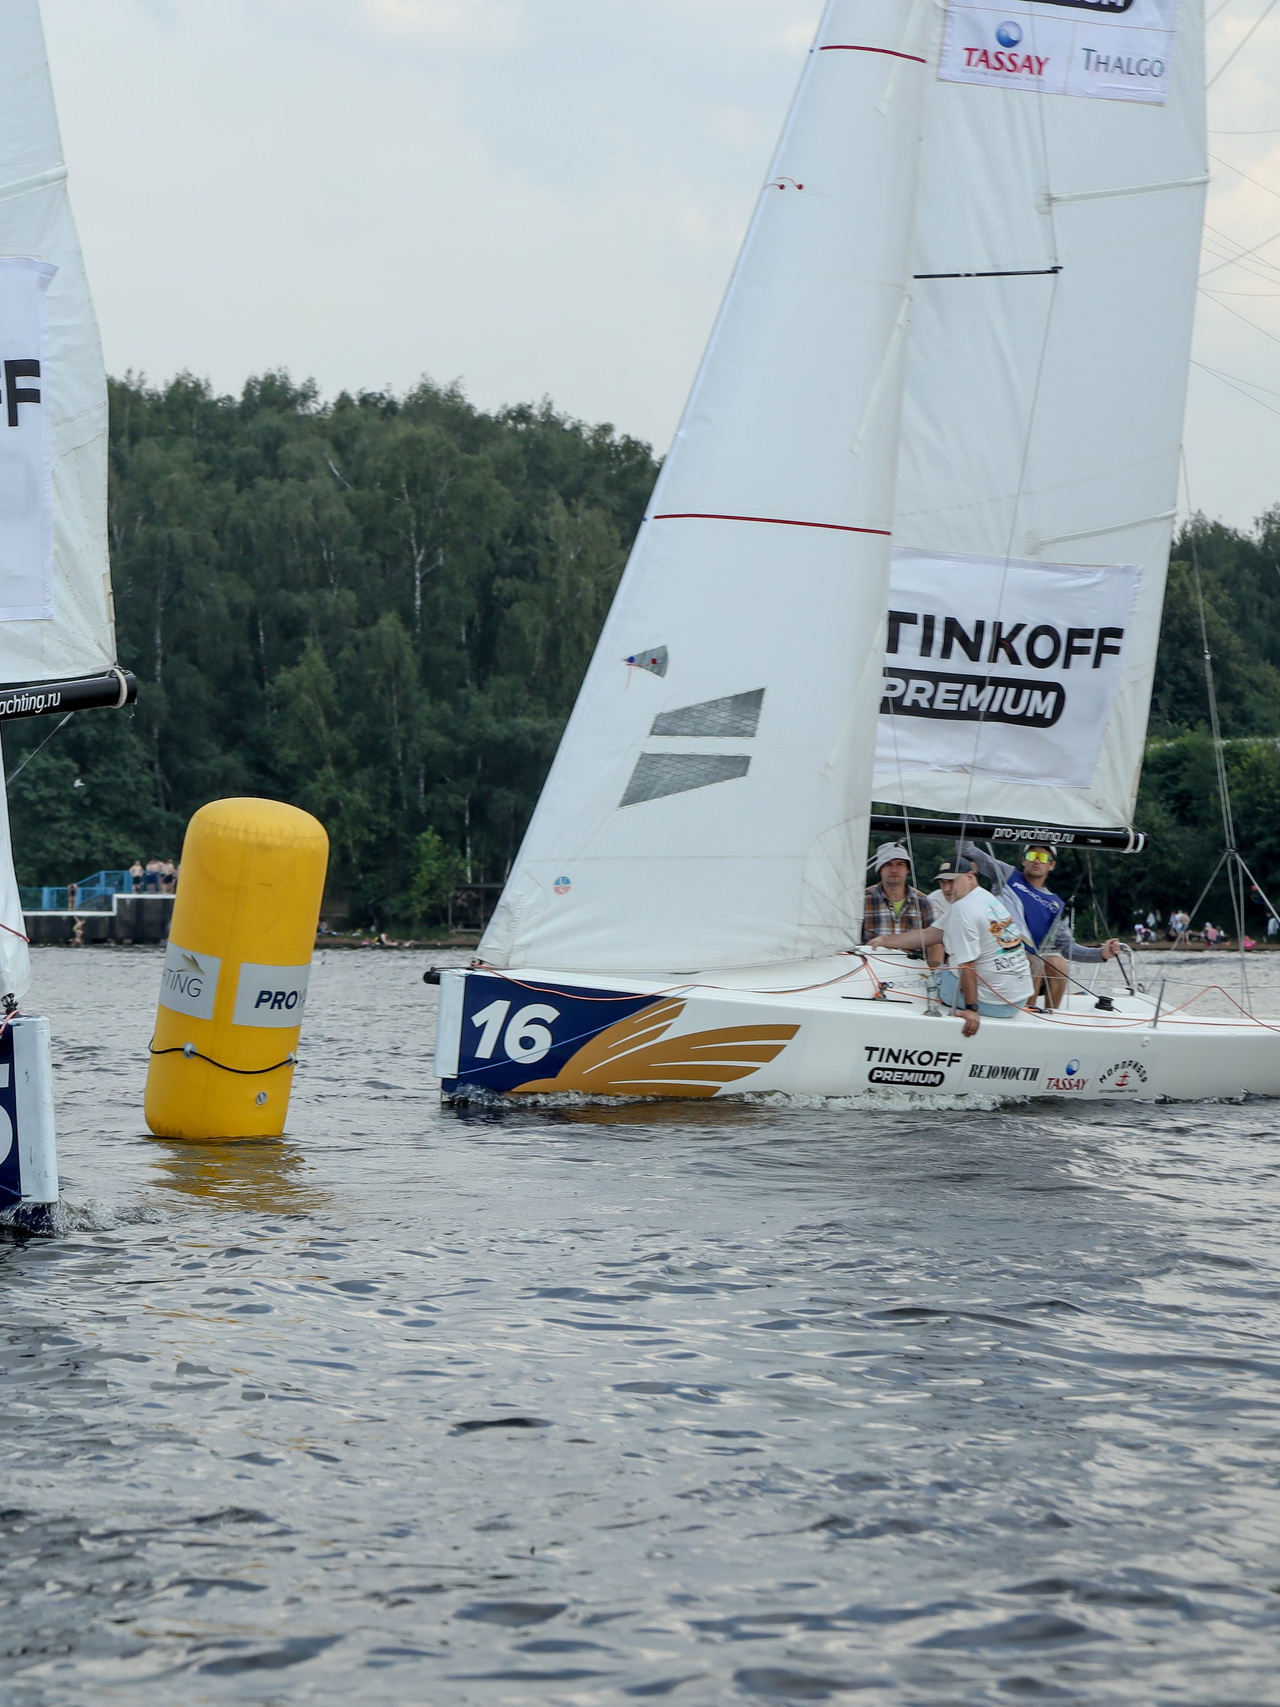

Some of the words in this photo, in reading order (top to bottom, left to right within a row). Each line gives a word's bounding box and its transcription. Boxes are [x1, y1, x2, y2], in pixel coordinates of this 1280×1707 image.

[963, 47, 1050, 77] TASSAY
[1081, 47, 1165, 78] THALGO
[886, 610, 1124, 669] TINKOFF
[882, 676, 1058, 719] PREMIUM
[991, 827, 1075, 844] pro-yachting.ru
[163, 971, 203, 998] TING
[471, 1000, 561, 1064] 16
[864, 1046, 962, 1068] TINKOFF
[871, 1070, 942, 1085] PREMIUM
[1046, 1078, 1089, 1090] TASSAY
